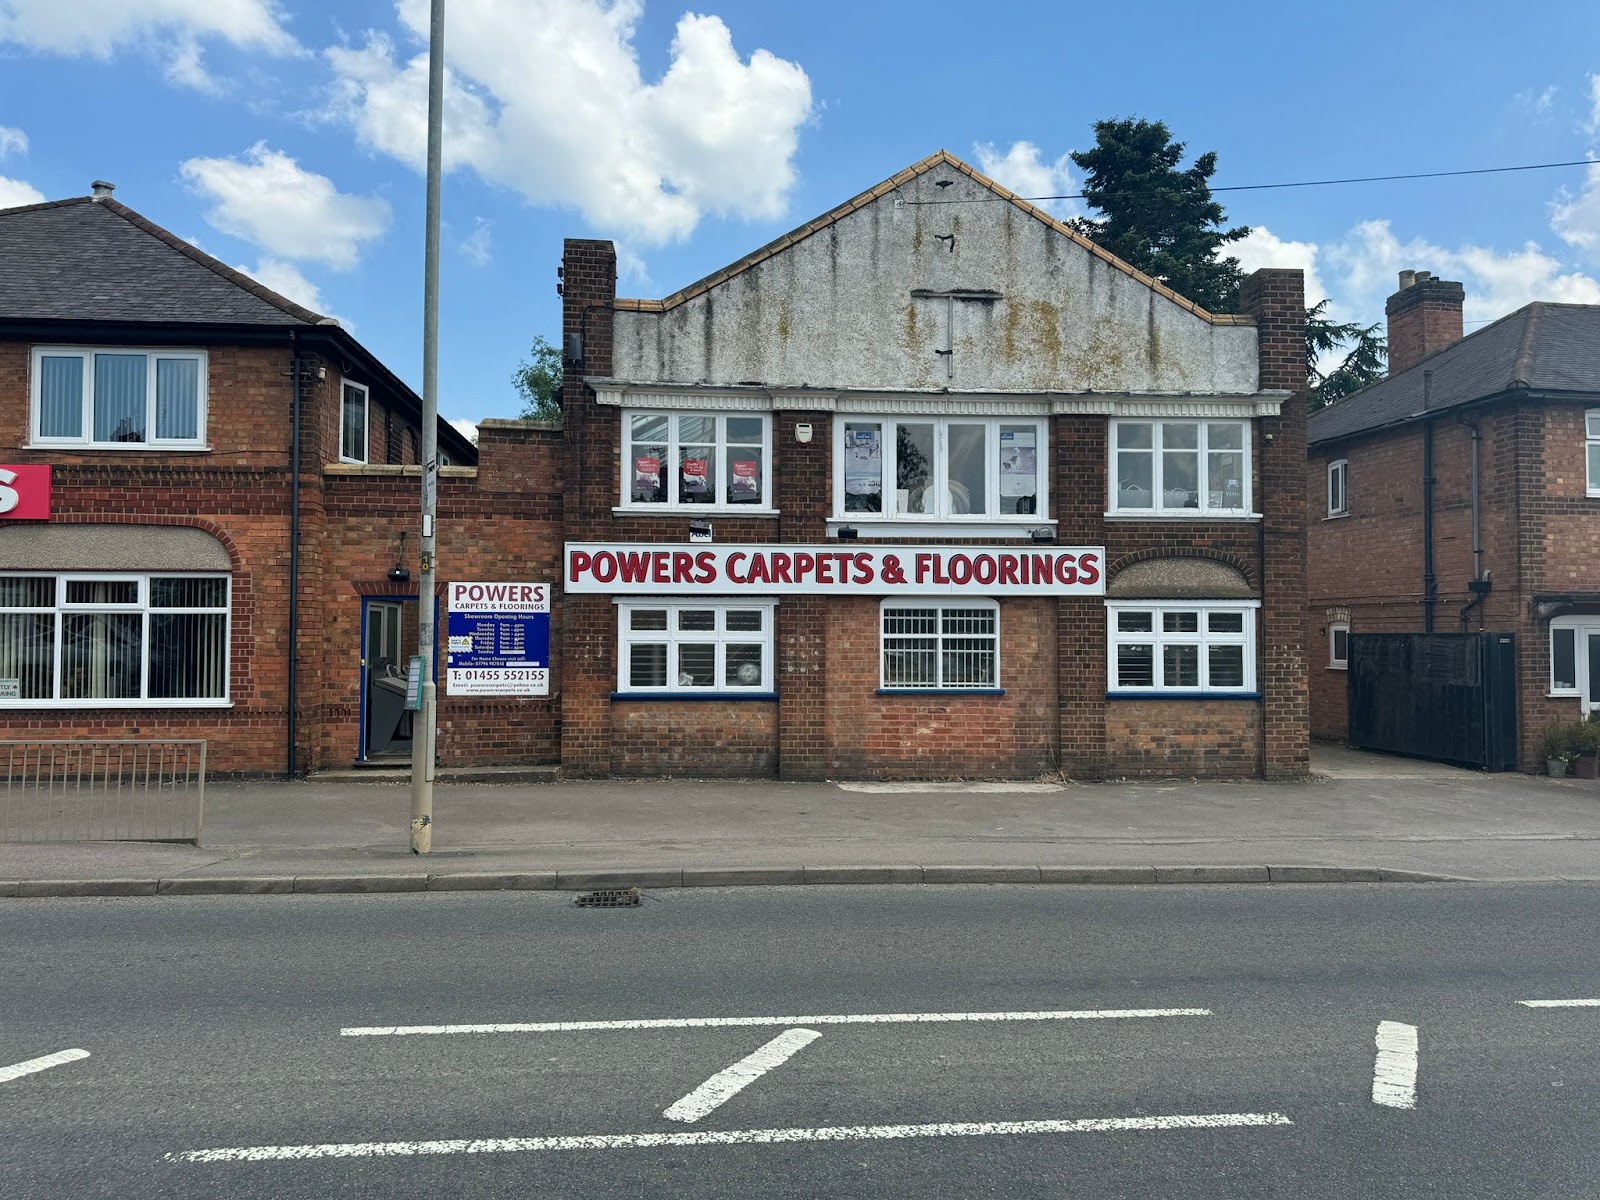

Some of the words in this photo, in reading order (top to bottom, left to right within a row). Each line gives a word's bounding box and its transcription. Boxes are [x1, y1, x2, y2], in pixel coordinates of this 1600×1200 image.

[569, 551, 717, 584] POWERS
[725, 551, 874, 585] CARPETS
[881, 554, 908, 585] &
[915, 553, 1100, 585] FLOORINGS
[455, 584, 544, 602] POWERS
[453, 671, 461, 680] T:
[466, 670, 500, 680] 01455
[504, 671, 544, 680] 552155
